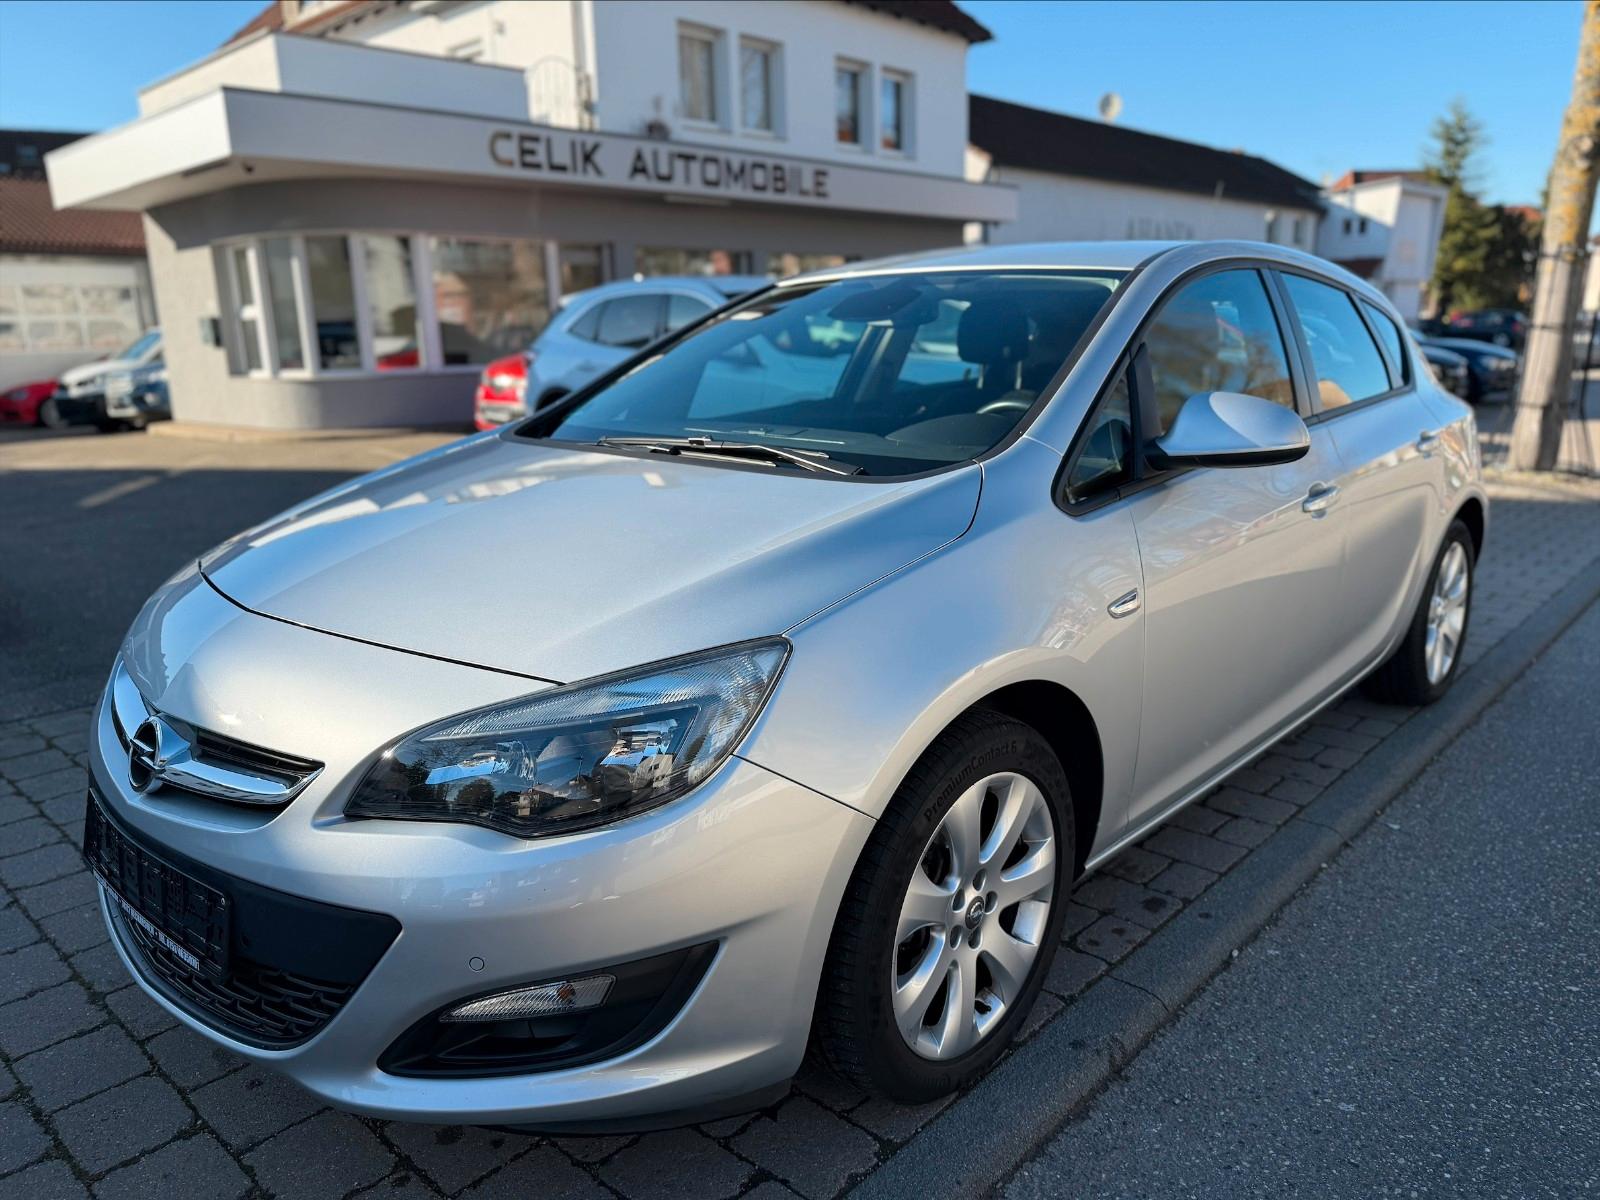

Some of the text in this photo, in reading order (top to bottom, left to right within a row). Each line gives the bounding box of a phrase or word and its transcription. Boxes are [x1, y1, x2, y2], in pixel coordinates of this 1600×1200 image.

[488, 131, 829, 198] CELIK AUTOMOBILE
[924, 744, 1010, 821] PremiumContact
